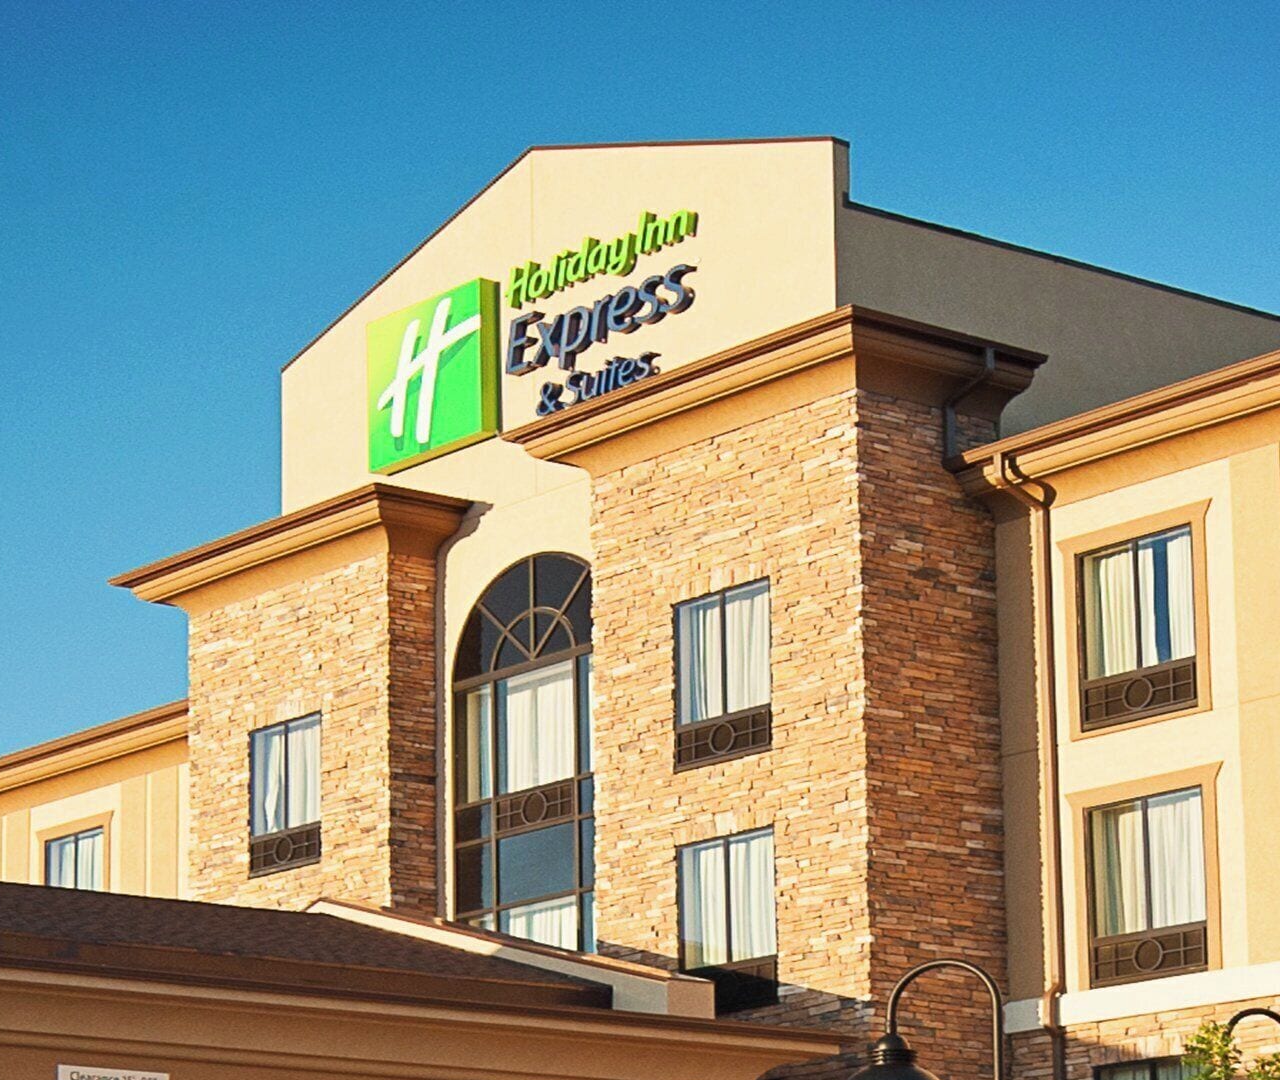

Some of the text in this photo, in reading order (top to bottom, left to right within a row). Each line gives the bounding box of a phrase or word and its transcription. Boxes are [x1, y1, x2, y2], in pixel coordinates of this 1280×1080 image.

[505, 208, 699, 309] Holiday Inn
[377, 297, 481, 444] H
[506, 264, 698, 376] Express
[536, 351, 661, 416] & Suites
